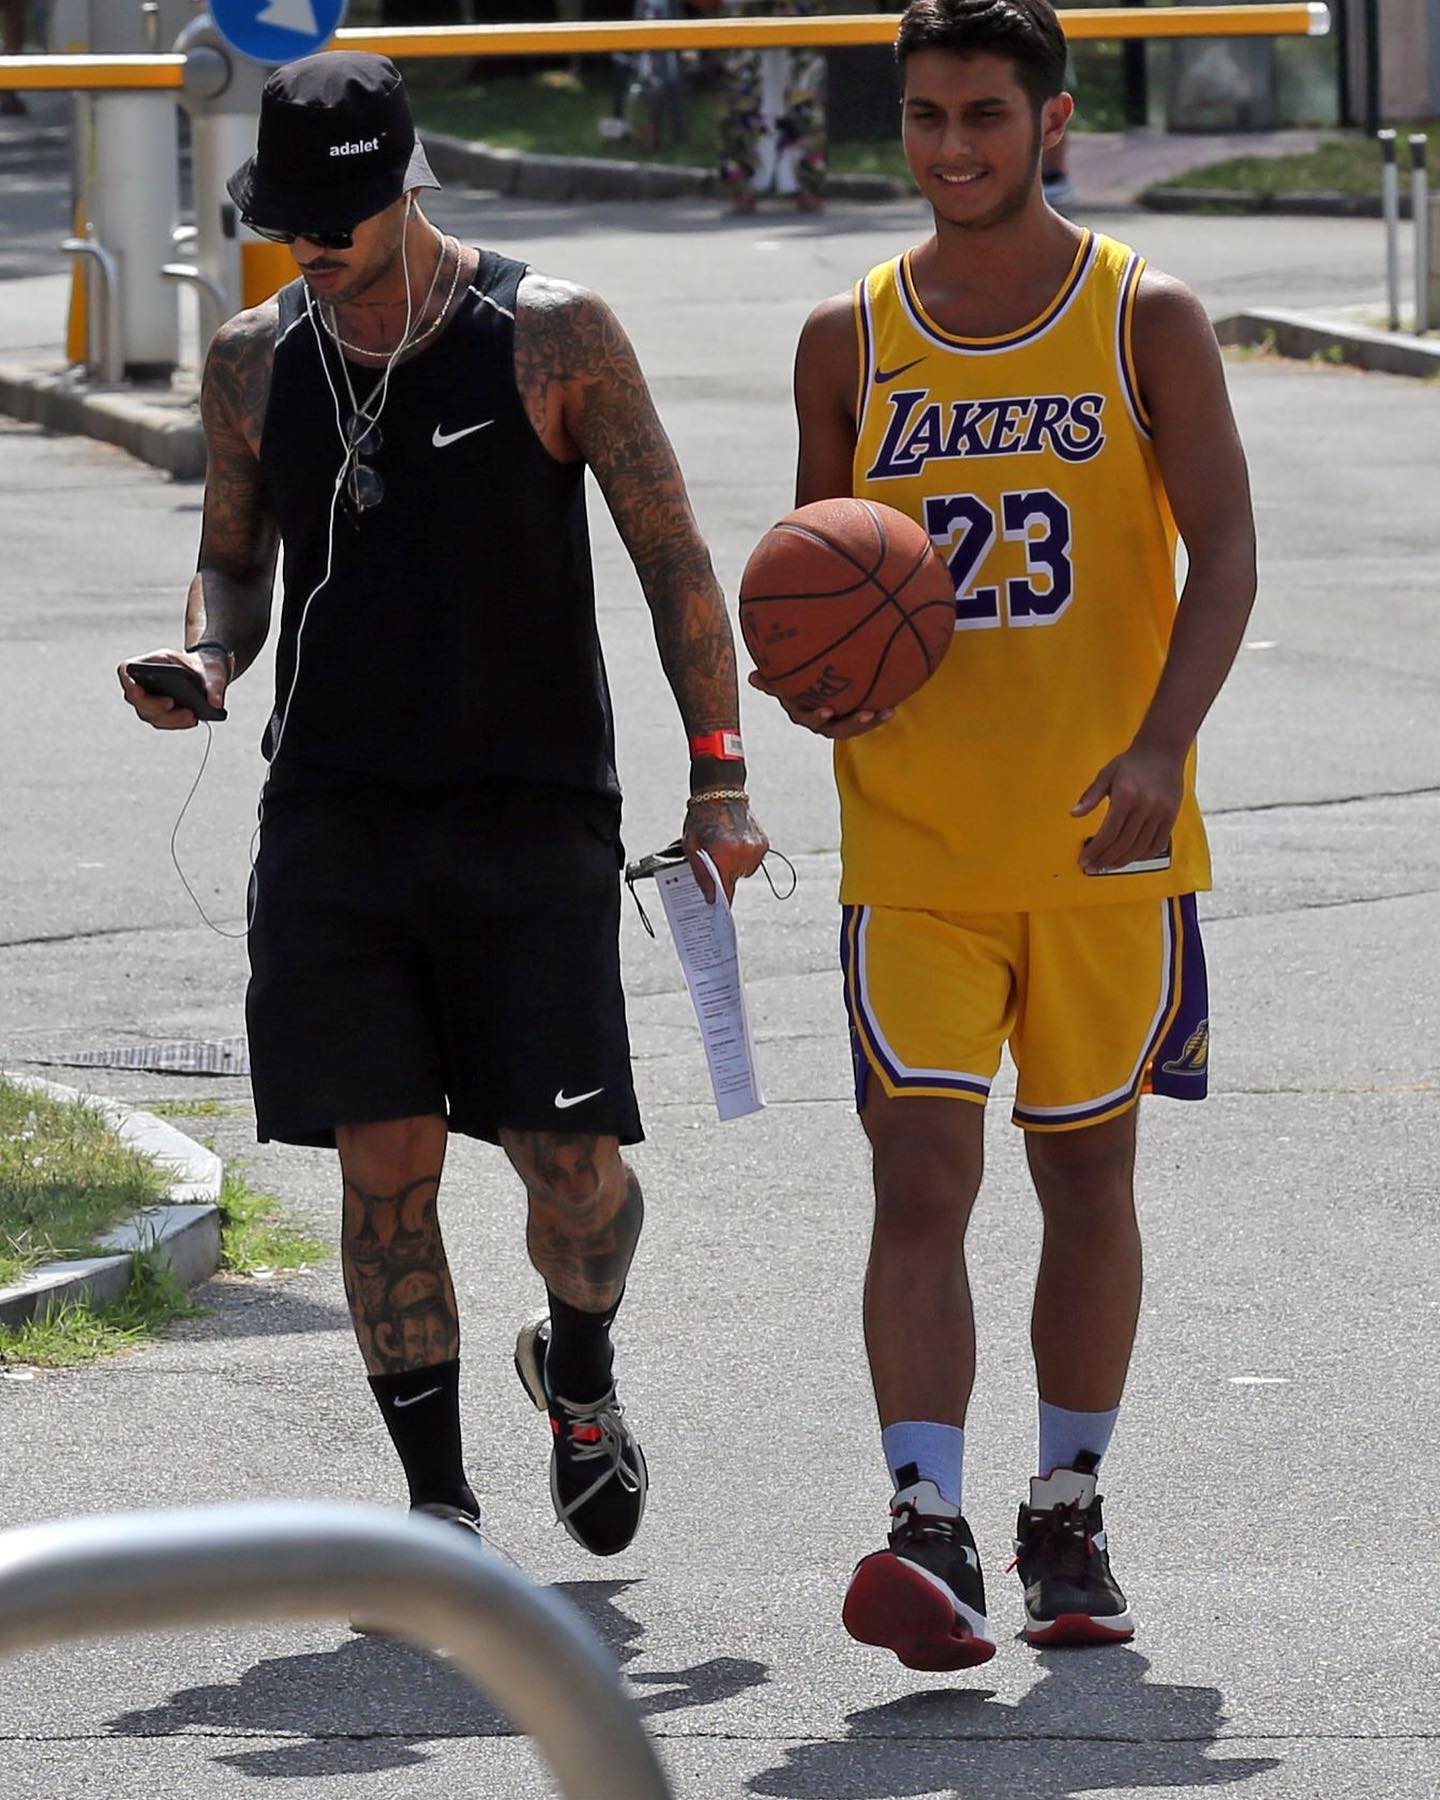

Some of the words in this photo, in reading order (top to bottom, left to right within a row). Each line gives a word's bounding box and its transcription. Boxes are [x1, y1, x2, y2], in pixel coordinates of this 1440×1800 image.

[329, 137, 379, 157] adalet
[866, 389, 1106, 482] LAKERS
[923, 488, 1074, 631] 23
